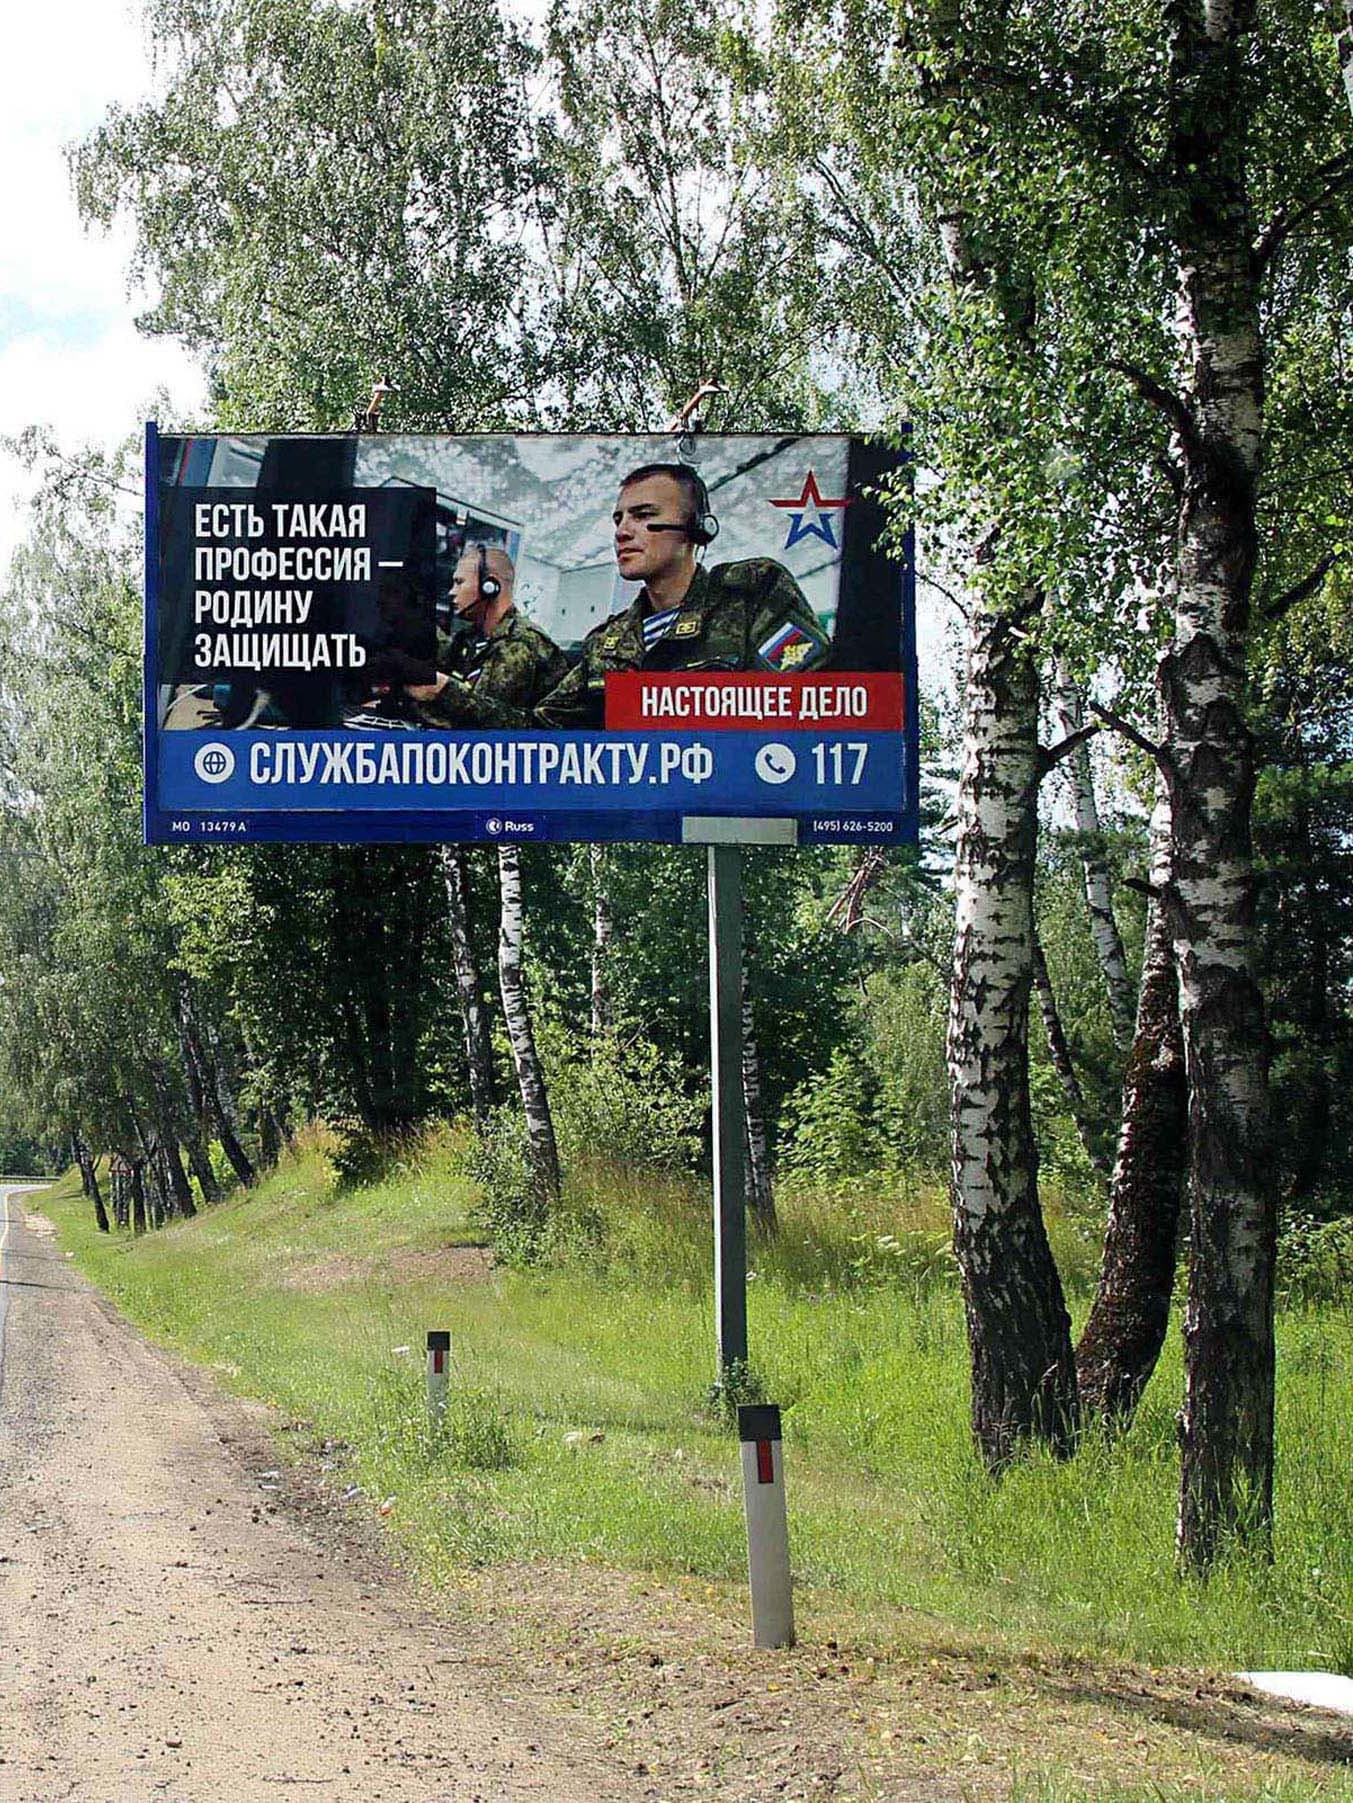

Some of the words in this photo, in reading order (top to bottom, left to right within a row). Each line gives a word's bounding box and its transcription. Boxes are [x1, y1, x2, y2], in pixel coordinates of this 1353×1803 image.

[194, 503, 265, 538] ЕСТЬ
[271, 503, 366, 538] ТАКАЯ
[194, 547, 371, 581] ПРОФЕССИЯ
[194, 590, 314, 628] РОДИНУ
[194, 633, 366, 671] ЗАЩИЩАТЬ
[641, 686, 793, 720] НАСТОЯЩЕЕ
[798, 686, 868, 720] ДЕЛО
[249, 742, 714, 785] СЛУЖБАПОКОНТРАКТУ.РФ
[811, 742, 869, 785] 117
[504, 821, 535, 832] Russ
[813, 820, 841, 832] (495)
[843, 821, 894, 832] 626-5200
